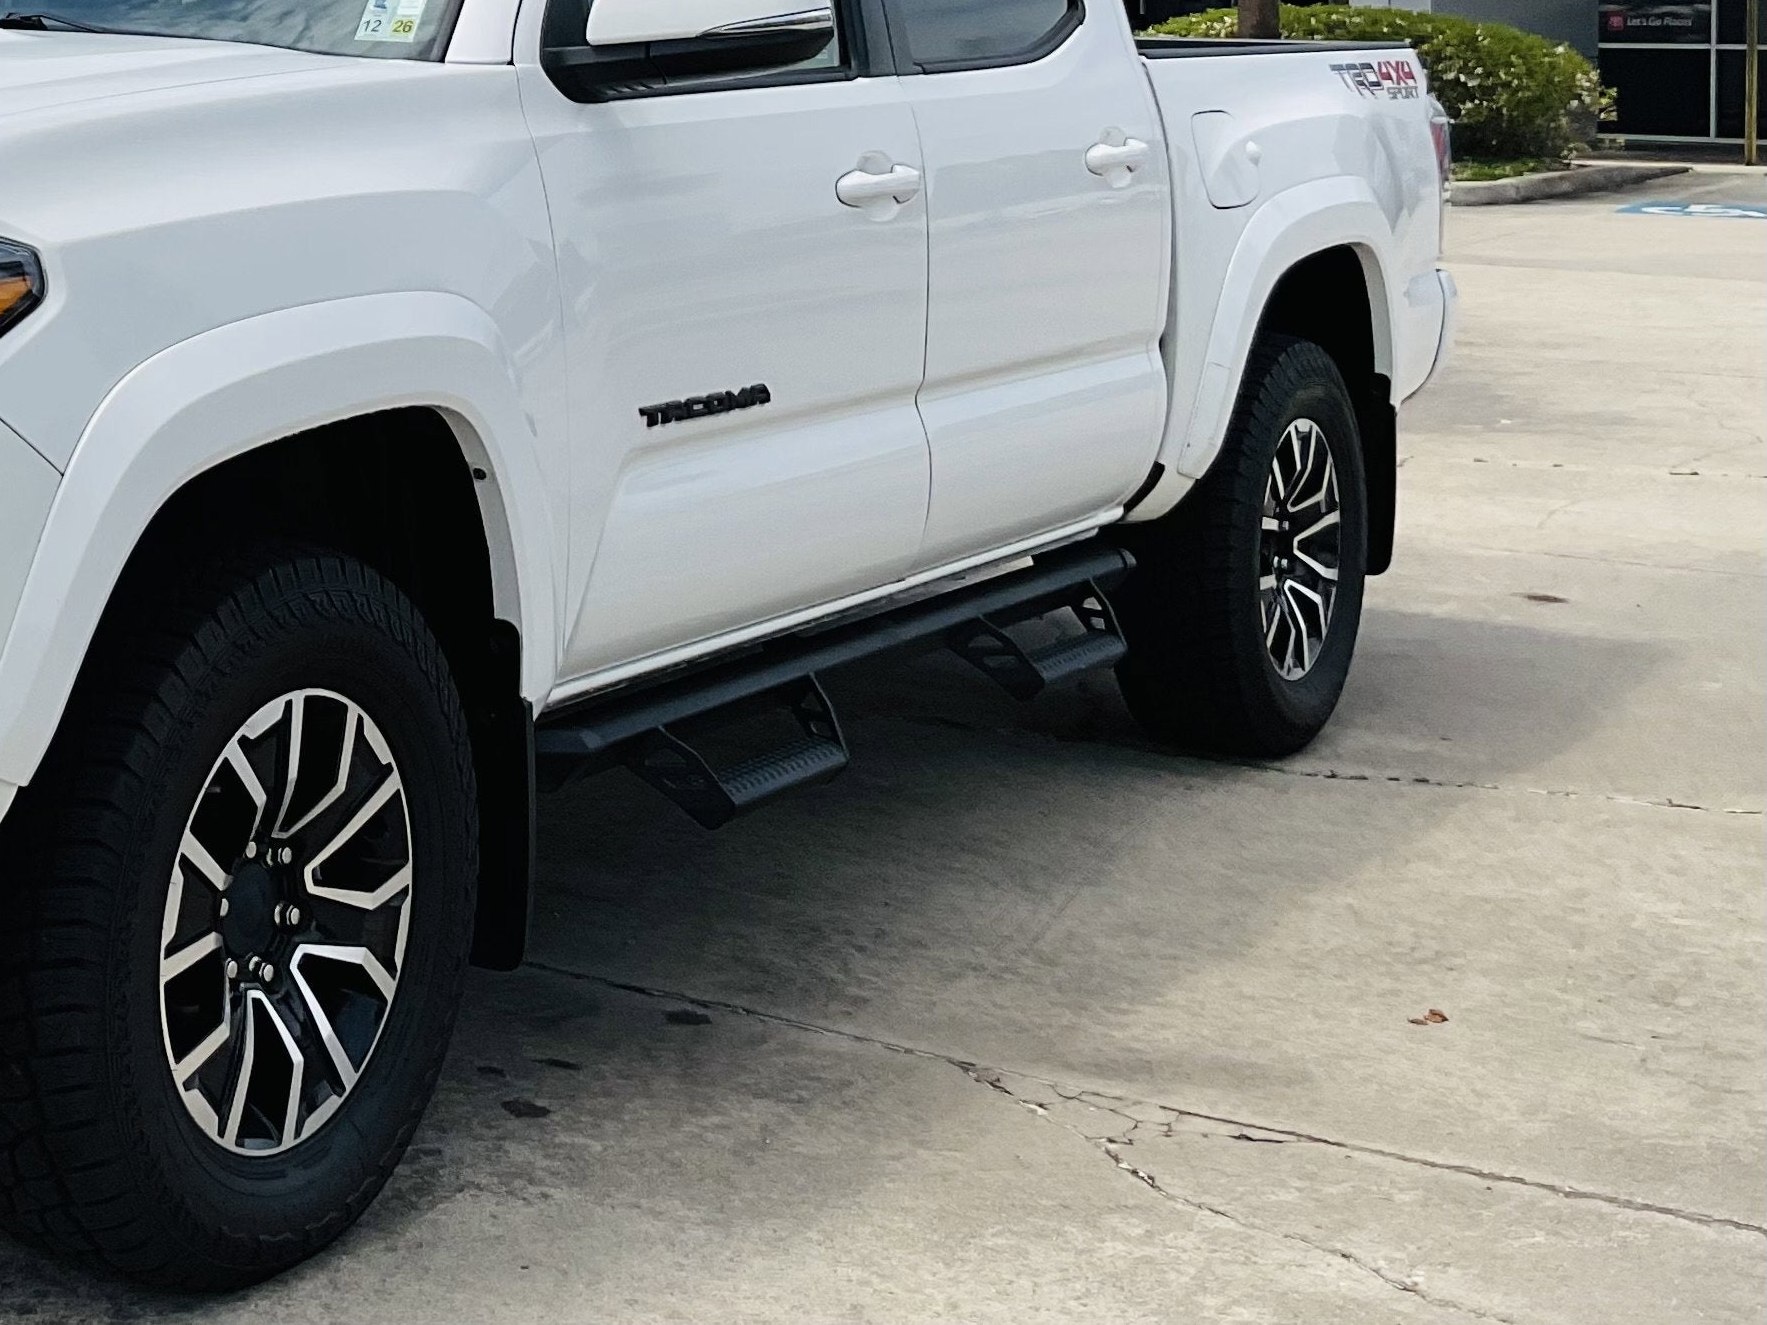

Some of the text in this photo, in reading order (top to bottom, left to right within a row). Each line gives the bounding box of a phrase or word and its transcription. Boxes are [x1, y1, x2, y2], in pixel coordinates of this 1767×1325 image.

[362, 19, 414, 33] 12 26
[1329, 62, 1385, 100] TRD
[1386, 86, 1419, 100] SPORT
[638, 383, 771, 428] TACOMA
